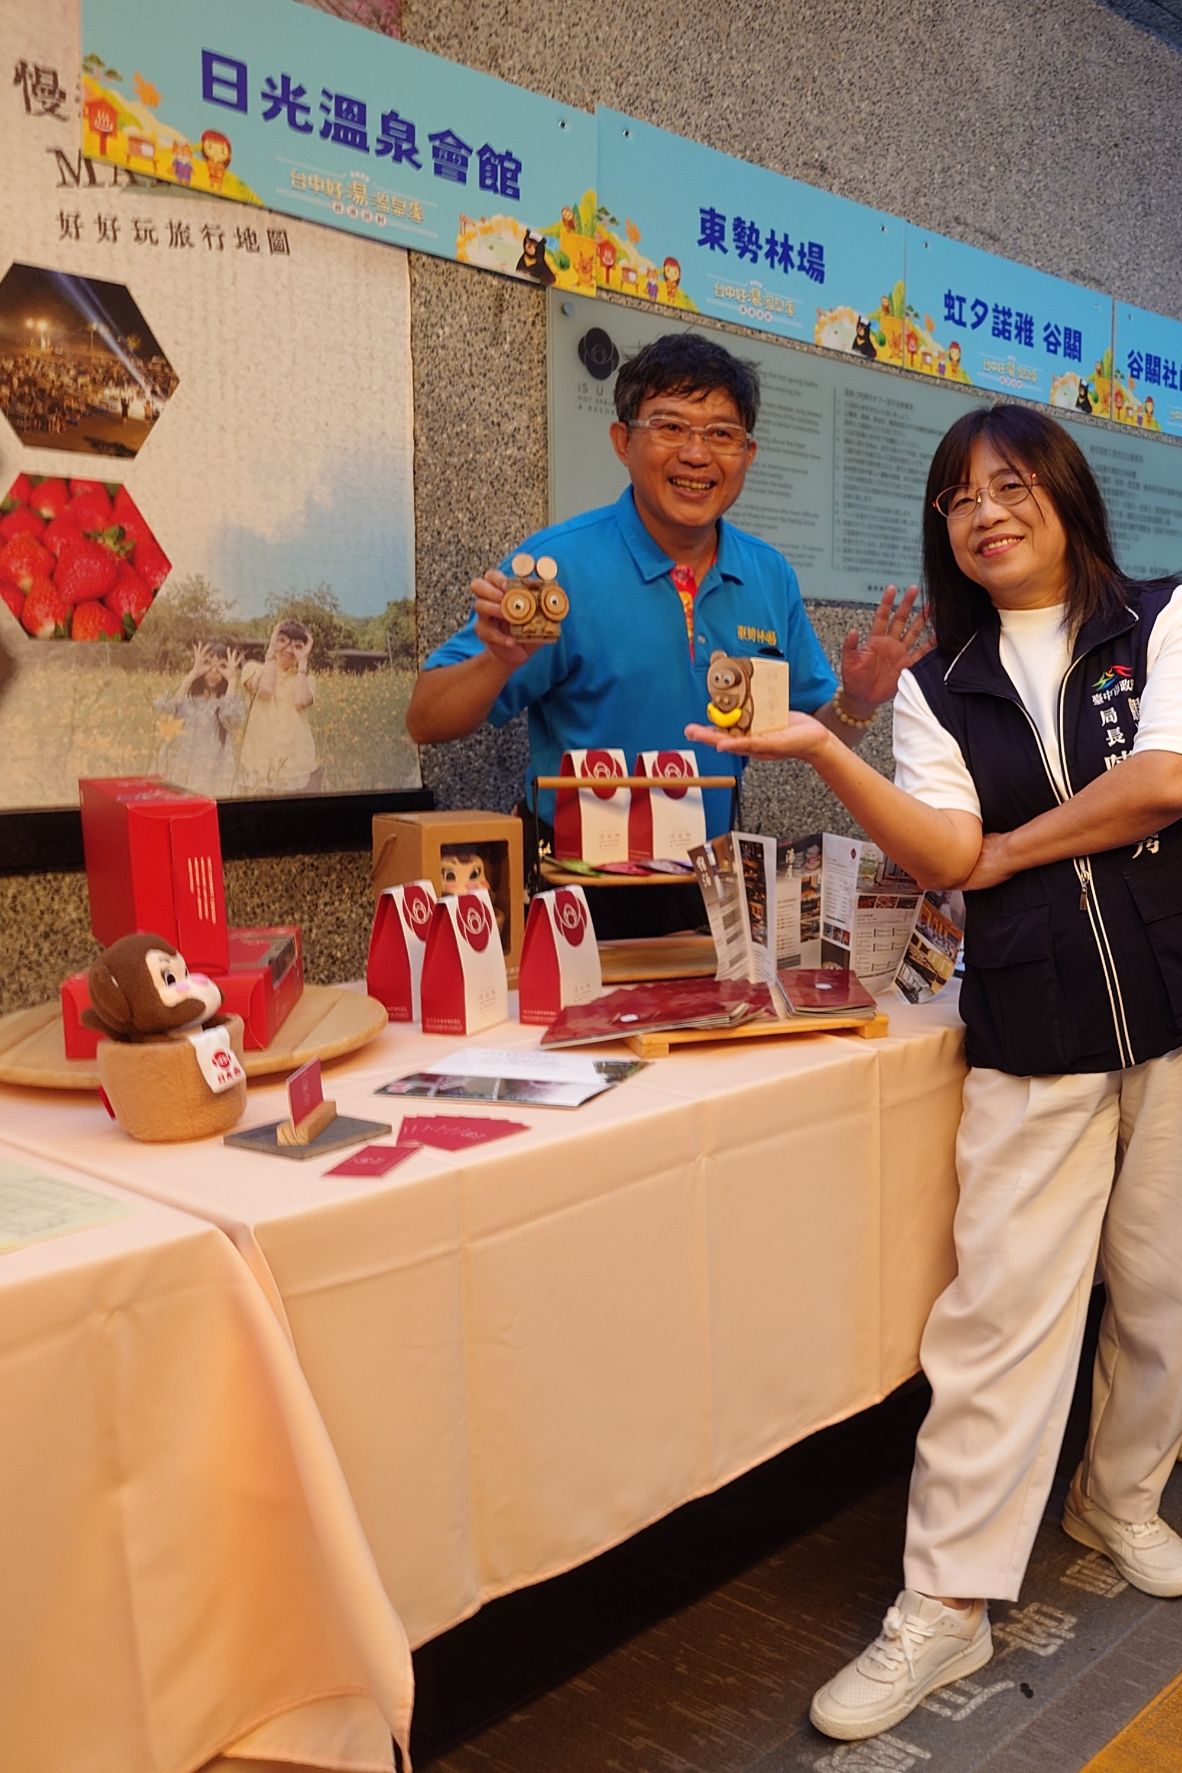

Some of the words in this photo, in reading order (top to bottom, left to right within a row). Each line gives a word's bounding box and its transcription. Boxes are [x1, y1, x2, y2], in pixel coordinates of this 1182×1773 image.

[13, 58, 80, 121] 慢
[201, 47, 523, 201] 日光溫泉會館
[56, 208, 291, 257] 好好玩旅行地圖
[697, 206, 826, 285] 東勢林場
[943, 288, 1035, 349] 虹夕諾雅
[1043, 321, 1083, 364] 谷關
